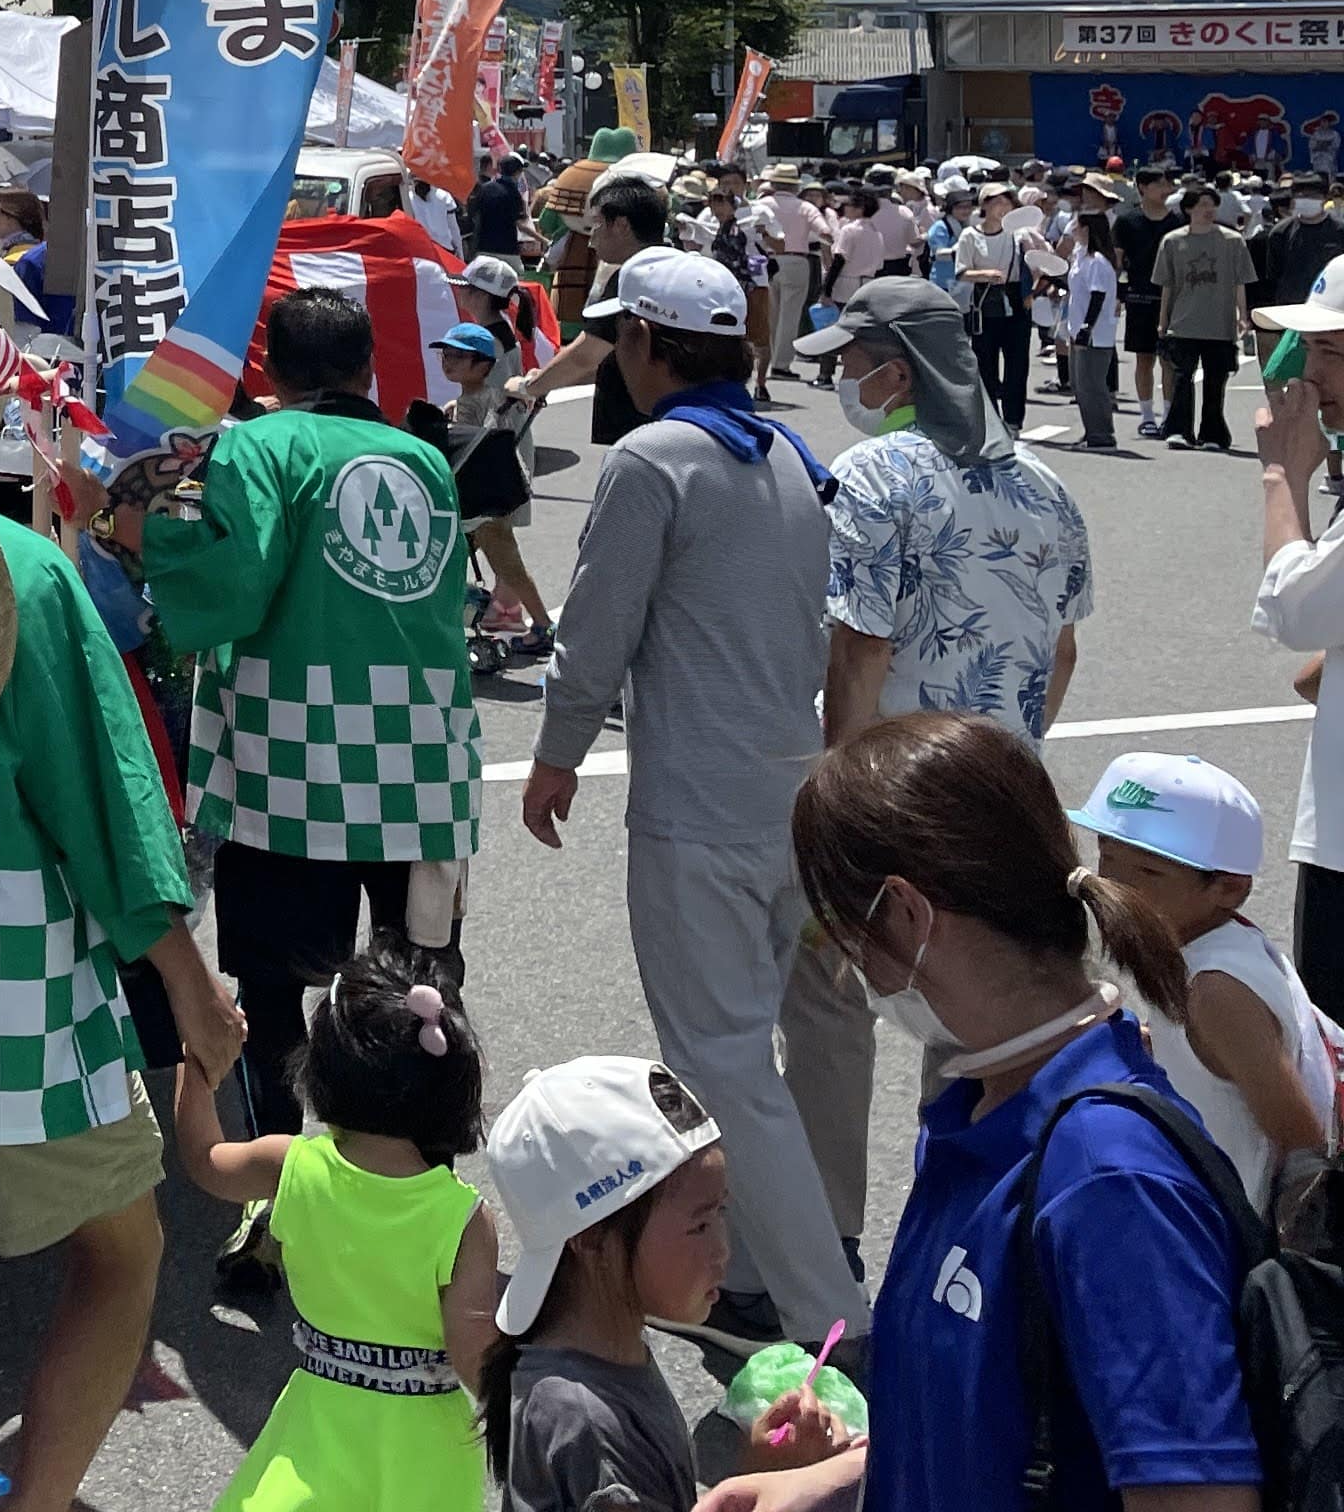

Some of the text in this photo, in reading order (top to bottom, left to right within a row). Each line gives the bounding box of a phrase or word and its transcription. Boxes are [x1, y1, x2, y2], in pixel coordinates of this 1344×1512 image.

[1078, 24, 1157, 45] 第37回
[1169, 19, 1344, 47] きのくに祭
